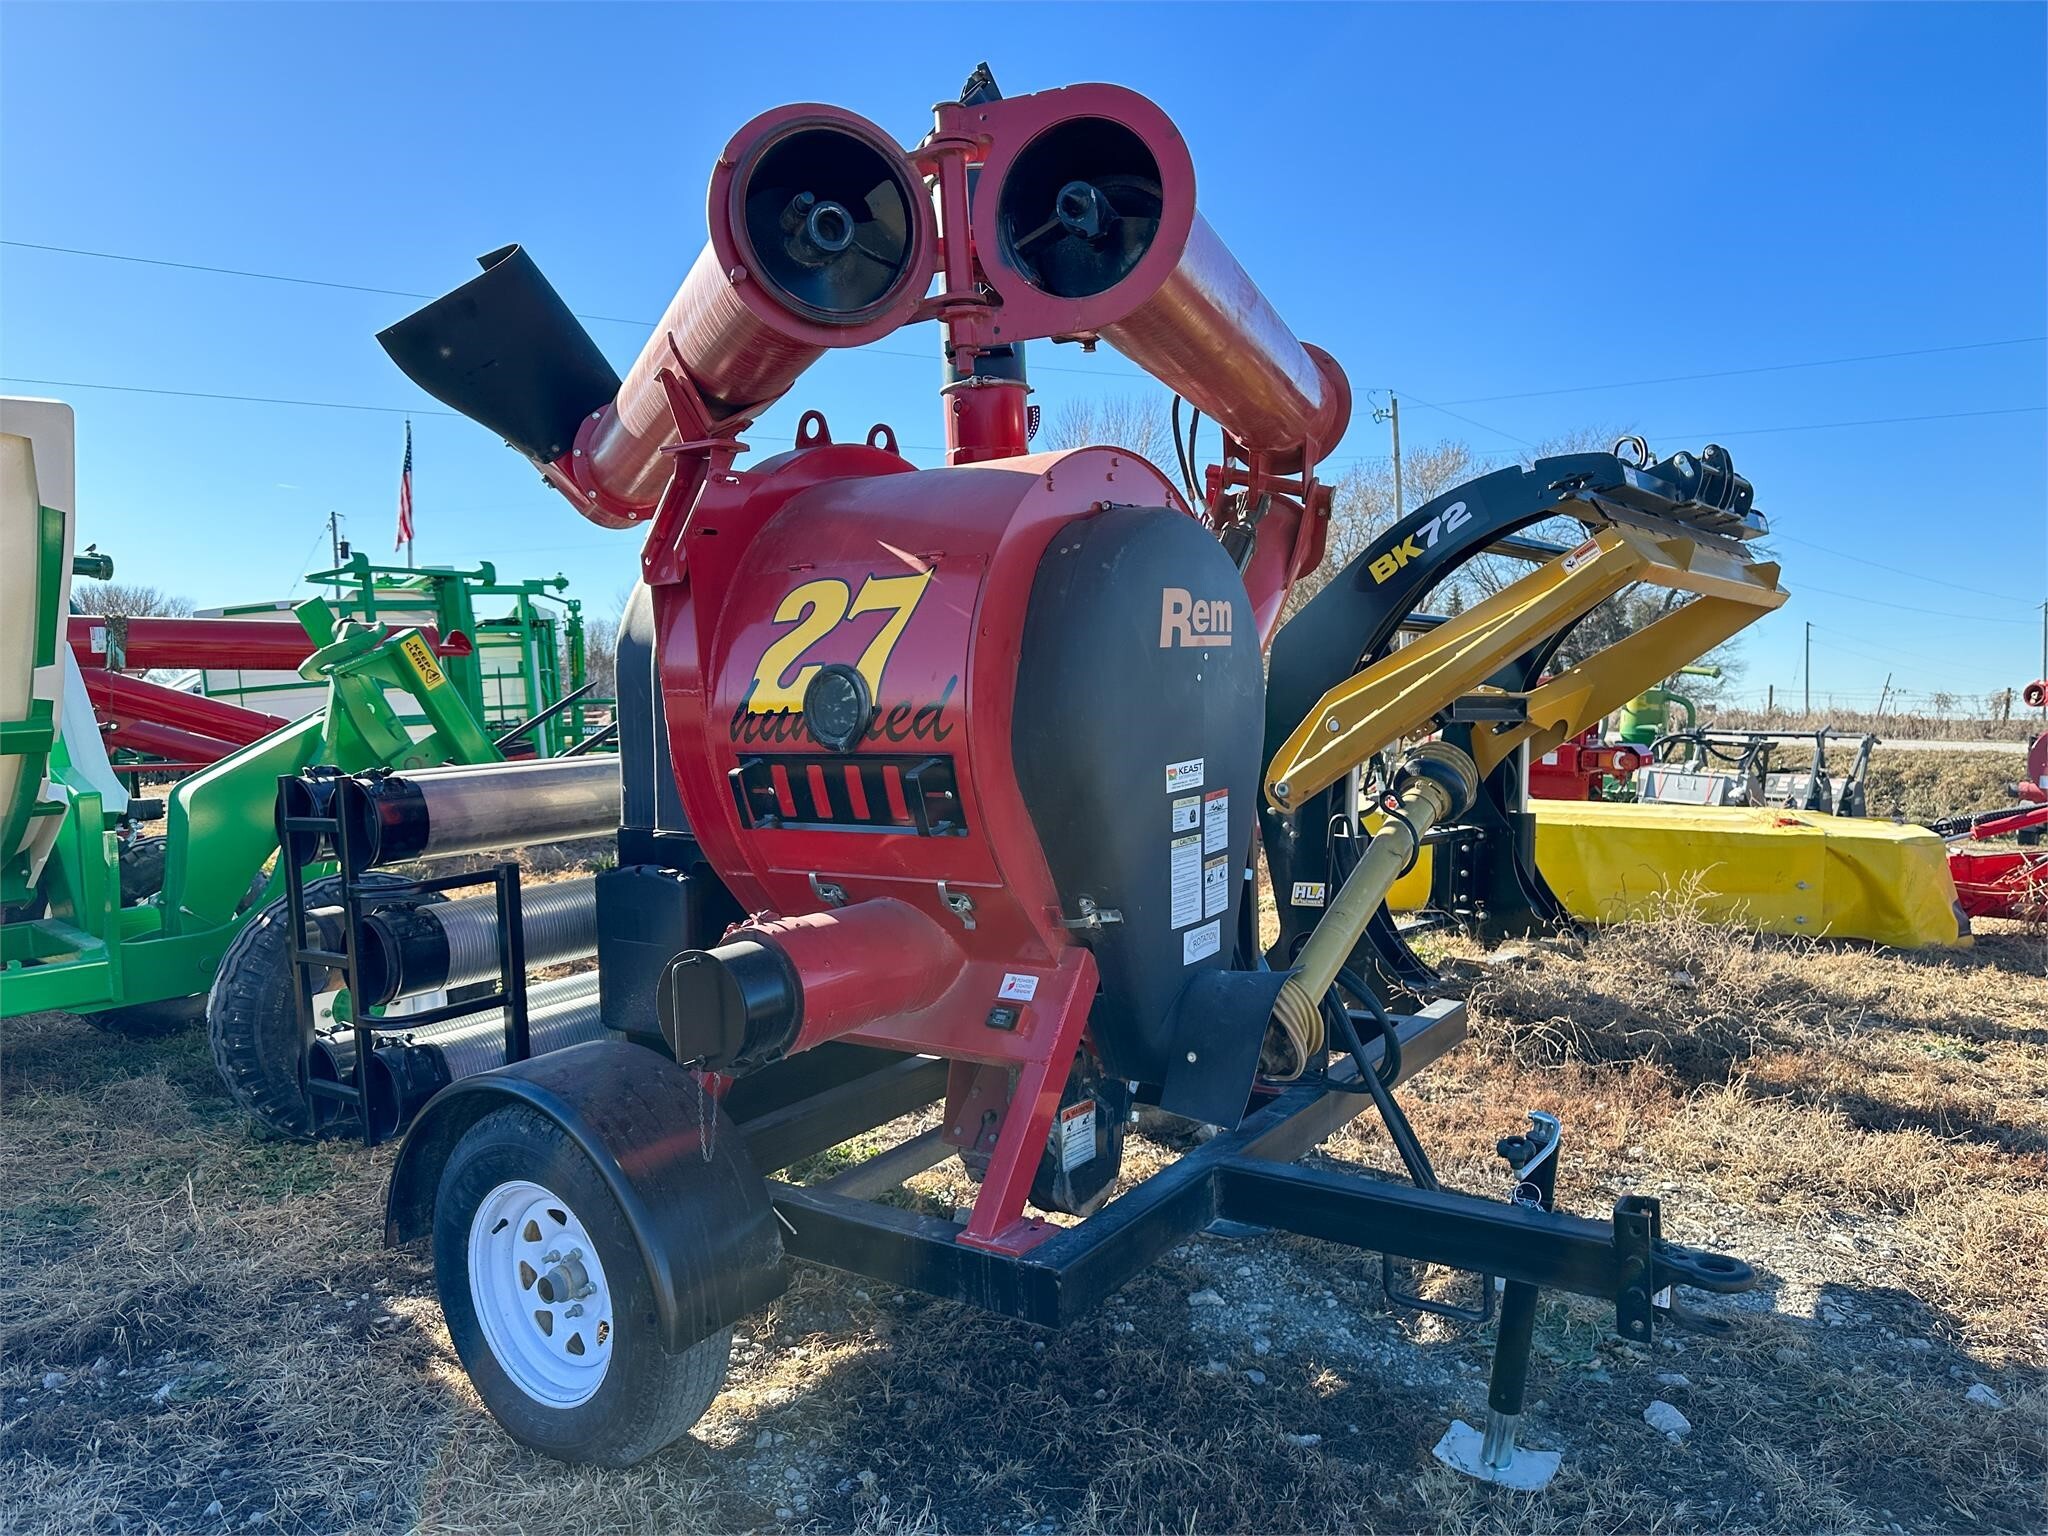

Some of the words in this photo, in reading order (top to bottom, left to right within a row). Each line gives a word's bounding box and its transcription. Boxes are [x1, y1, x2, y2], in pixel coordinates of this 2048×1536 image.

[1368, 501, 1473, 585] BK72
[1160, 587, 1232, 648] Rem
[748, 565, 938, 716] 27
[405, 642, 426, 672] CLEAR
[413, 643, 431, 668] KEEP
[1179, 762, 1203, 775] KEAST
[1180, 836, 1198, 846] CAUTION
[1295, 885, 1325, 899] HLA
